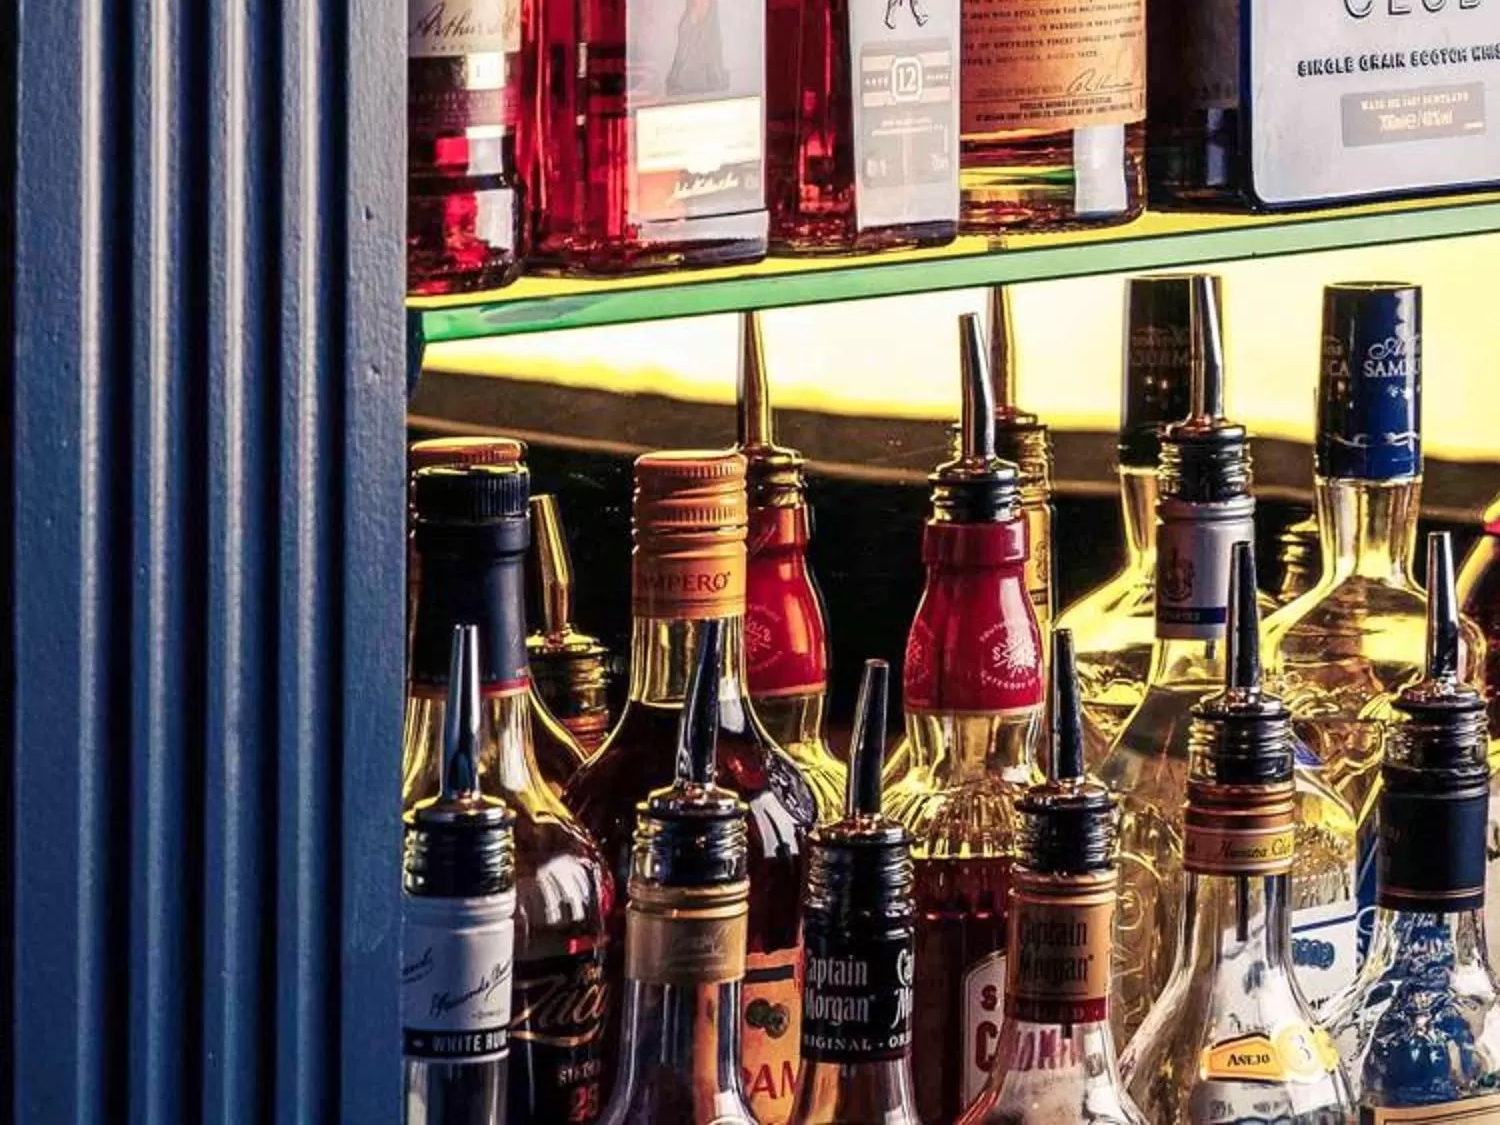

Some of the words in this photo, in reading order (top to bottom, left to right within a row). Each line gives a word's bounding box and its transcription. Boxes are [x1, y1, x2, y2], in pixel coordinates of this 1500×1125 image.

[1296, 55, 1354, 78] SINGLE
[1358, 51, 1406, 73] GRAIN
[1410, 46, 1468, 69] SCOTCH
[898, 65, 918, 92] 12
